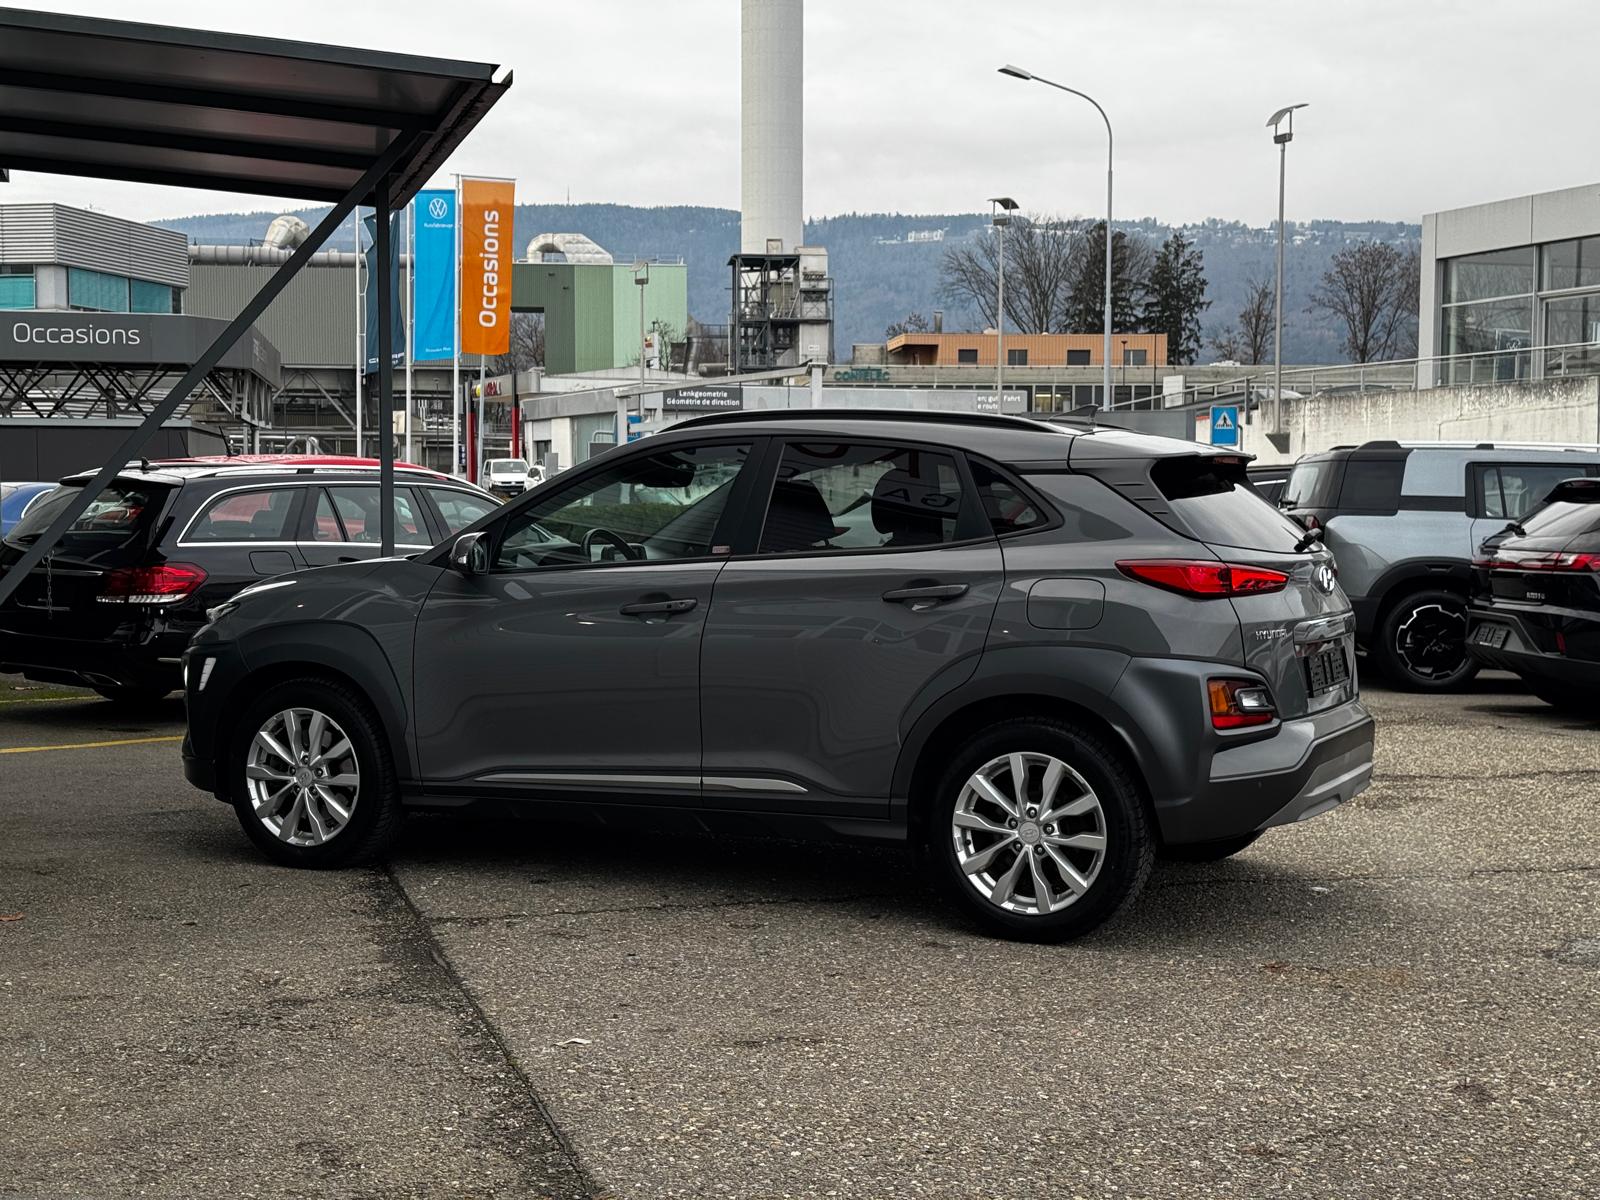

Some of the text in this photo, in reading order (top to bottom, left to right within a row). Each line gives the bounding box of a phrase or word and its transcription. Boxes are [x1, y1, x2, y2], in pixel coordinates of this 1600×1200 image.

[478, 209, 499, 328] Occasions
[13, 322, 140, 345] Occasions
[679, 390, 728, 398] Lenkgeometrie
[1003, 394, 1021, 402] Fahrt
[666, 397, 700, 405] Géométrie
